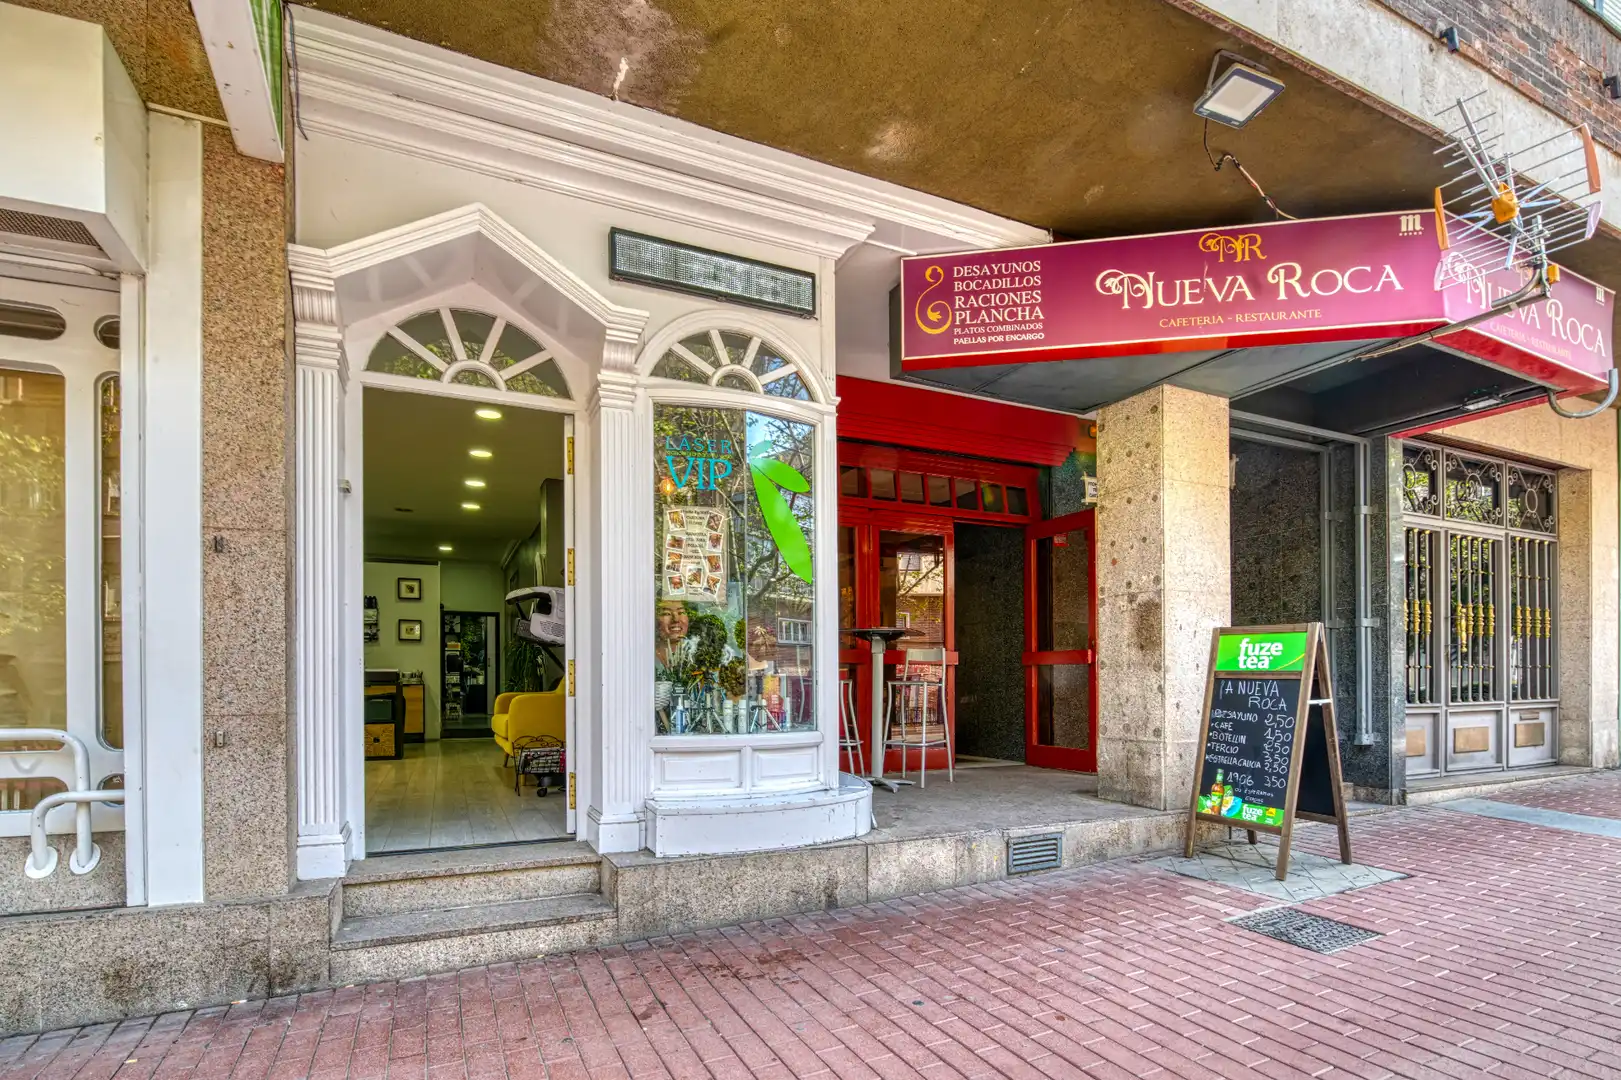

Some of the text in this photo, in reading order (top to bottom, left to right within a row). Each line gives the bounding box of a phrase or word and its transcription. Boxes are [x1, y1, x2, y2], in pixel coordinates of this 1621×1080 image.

[953, 260, 1041, 278] DESAYUNOS
[953, 275, 1042, 292] BOCADILLOS
[1095, 261, 1404, 309] NUEVA ROCA
[954, 289, 1042, 309] RACIONES
[955, 305, 1045, 325] PLANCHA
[1235, 308, 1322, 323] RESTAURANTE
[954, 322, 1043, 335] PLATOS COMBINADOS
[1547, 299, 1606, 357] ROCA
[953, 332, 1045, 345] PAELLAS POR ENCARGO
[665, 455, 733, 491] VIP
[1240, 637, 1283, 656] fuze
[1238, 654, 1270, 669] tea
[1237, 680, 1280, 697] NUEVA
[1248, 696, 1287, 712] ROCA
[1264, 713, 1295, 729] 2,50
[1212, 731, 1246, 745] BOTELLIN
[1263, 728, 1292, 743] 1,50
[1211, 742, 1239, 754] TERCIO
[1242, 804, 1263, 817] fuze
[1242, 812, 1257, 821] tea
